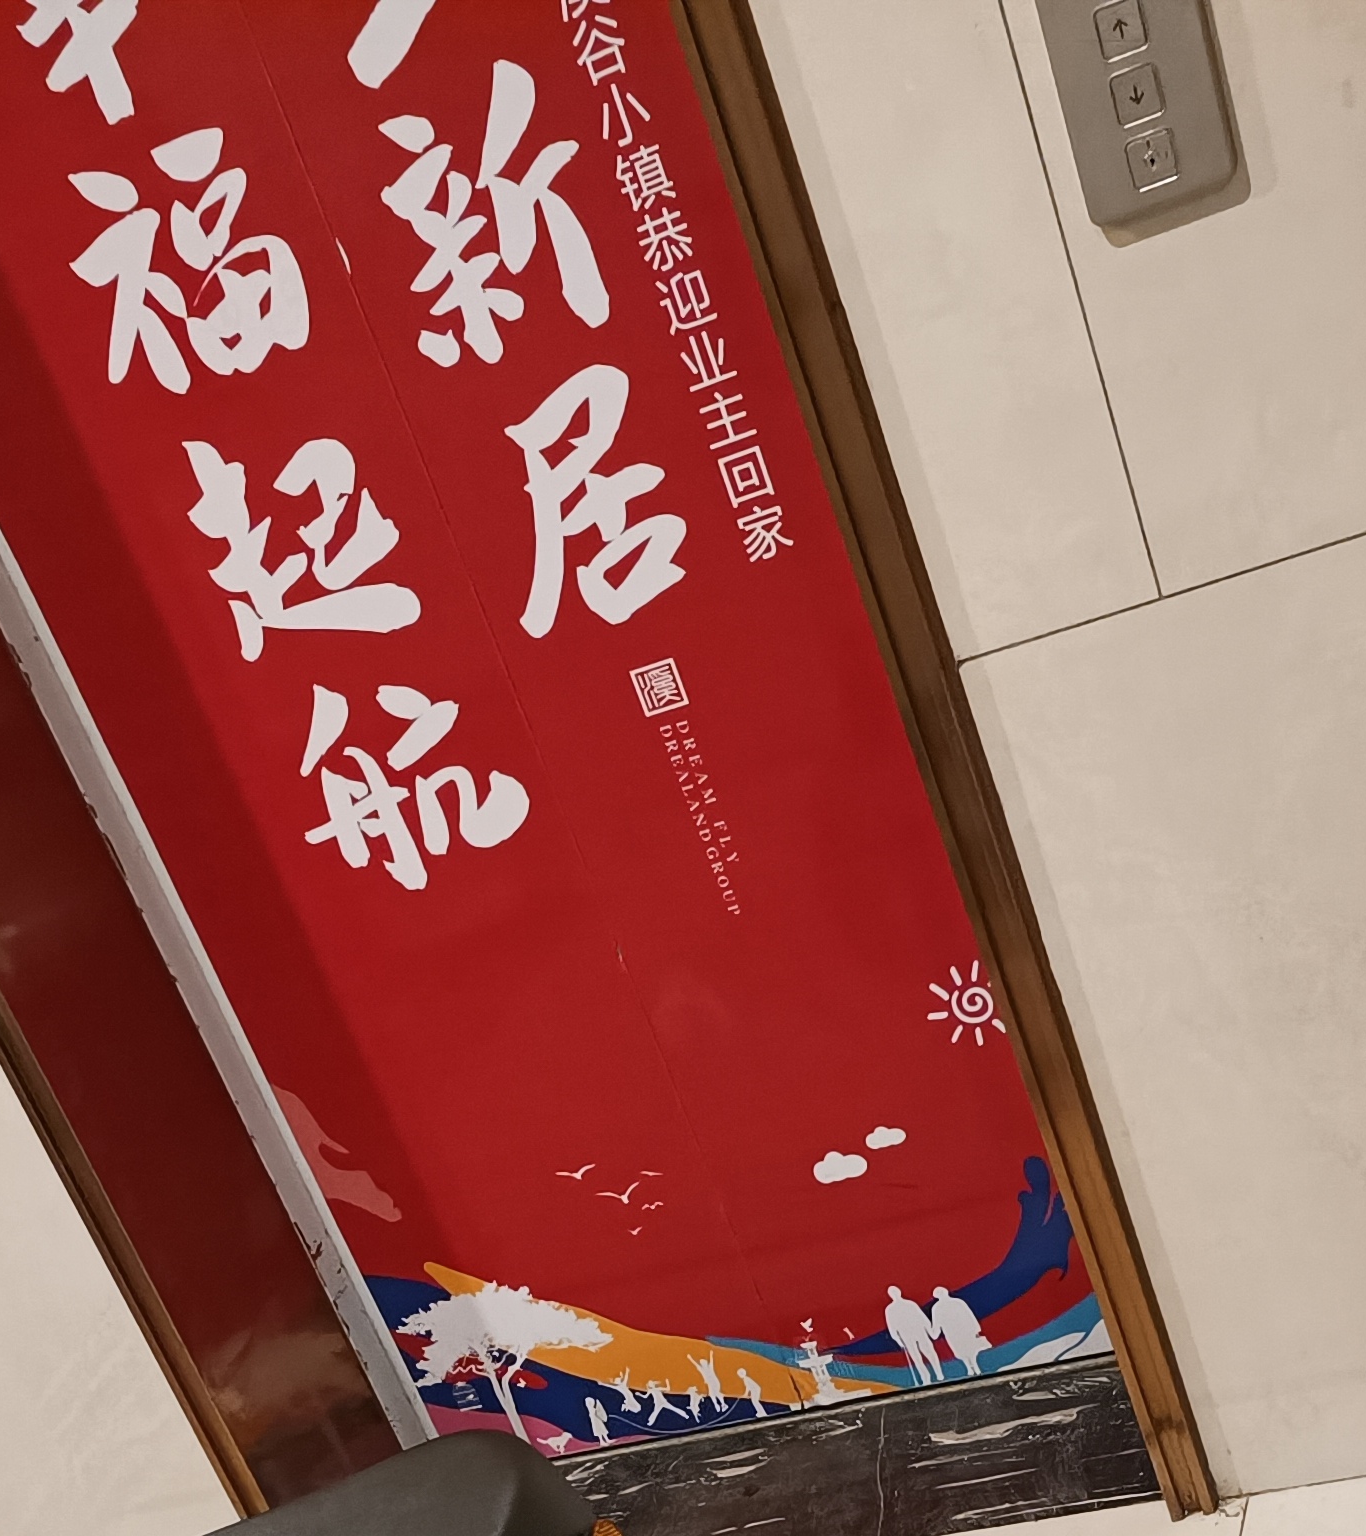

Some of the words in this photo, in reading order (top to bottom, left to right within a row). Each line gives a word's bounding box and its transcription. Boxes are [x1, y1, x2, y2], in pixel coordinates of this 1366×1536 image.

[347, 0, 687, 639] 新居
[675, 719, 717, 805] DREAM
[713, 820, 740, 864] FLY
